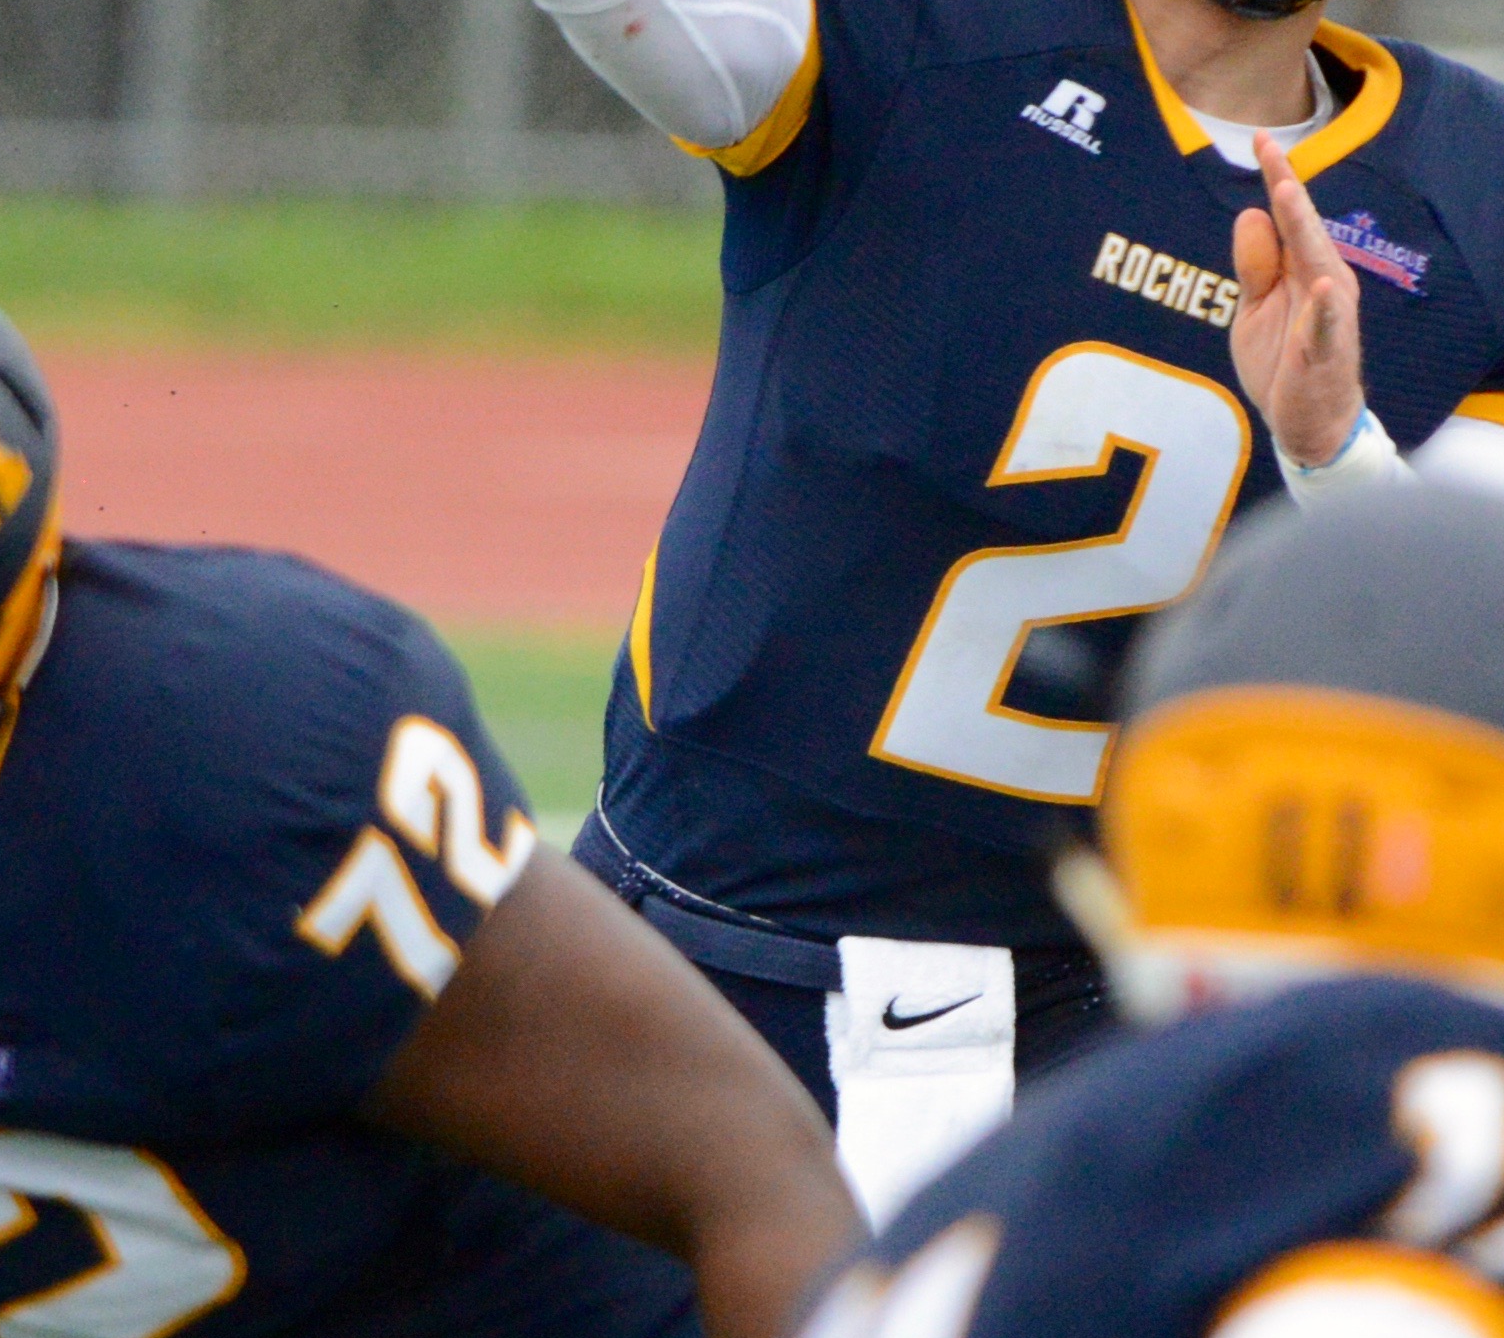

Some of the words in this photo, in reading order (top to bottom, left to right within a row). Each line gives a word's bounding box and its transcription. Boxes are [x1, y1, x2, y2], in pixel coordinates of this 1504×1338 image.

[1020, 104, 1102, 155] RUSSELL
[1040, 78, 1107, 131] R
[868, 340, 1254, 807] 2
[295, 714, 537, 1003] 72
